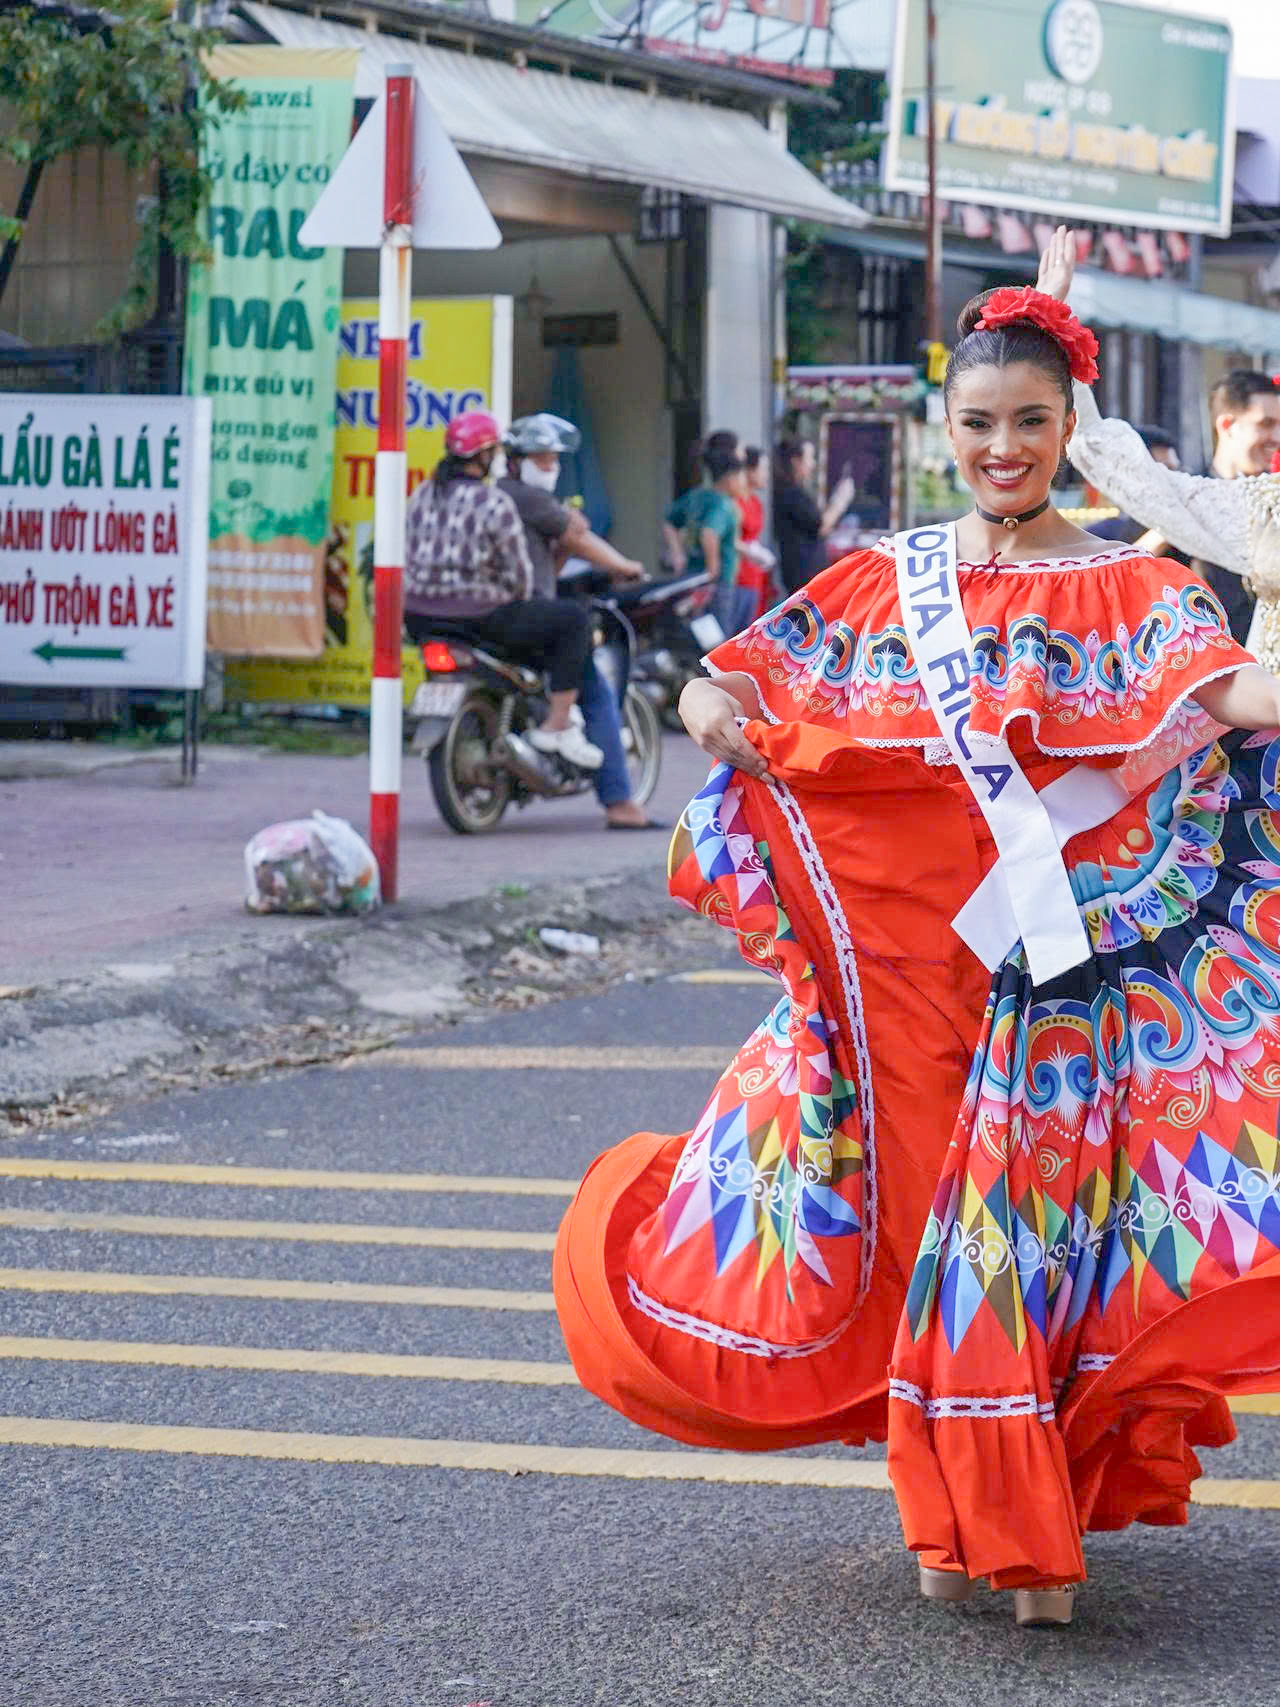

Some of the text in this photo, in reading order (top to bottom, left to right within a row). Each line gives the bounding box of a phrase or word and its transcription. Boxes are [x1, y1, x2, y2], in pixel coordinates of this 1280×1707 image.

[209, 279, 314, 350] MÁ
[204, 374, 247, 394] MIX
[0, 411, 180, 489] LẨU GÀ LÁ É
[0, 500, 44, 551] ÁNH
[94, 500, 145, 554] LÒNG
[153, 502, 178, 556] GÀ
[43, 574, 101, 636] TRỘN
[109, 574, 138, 628] GÀ
[146, 576, 174, 629] XÉ
[906, 523, 1014, 803] OSTA RICA
